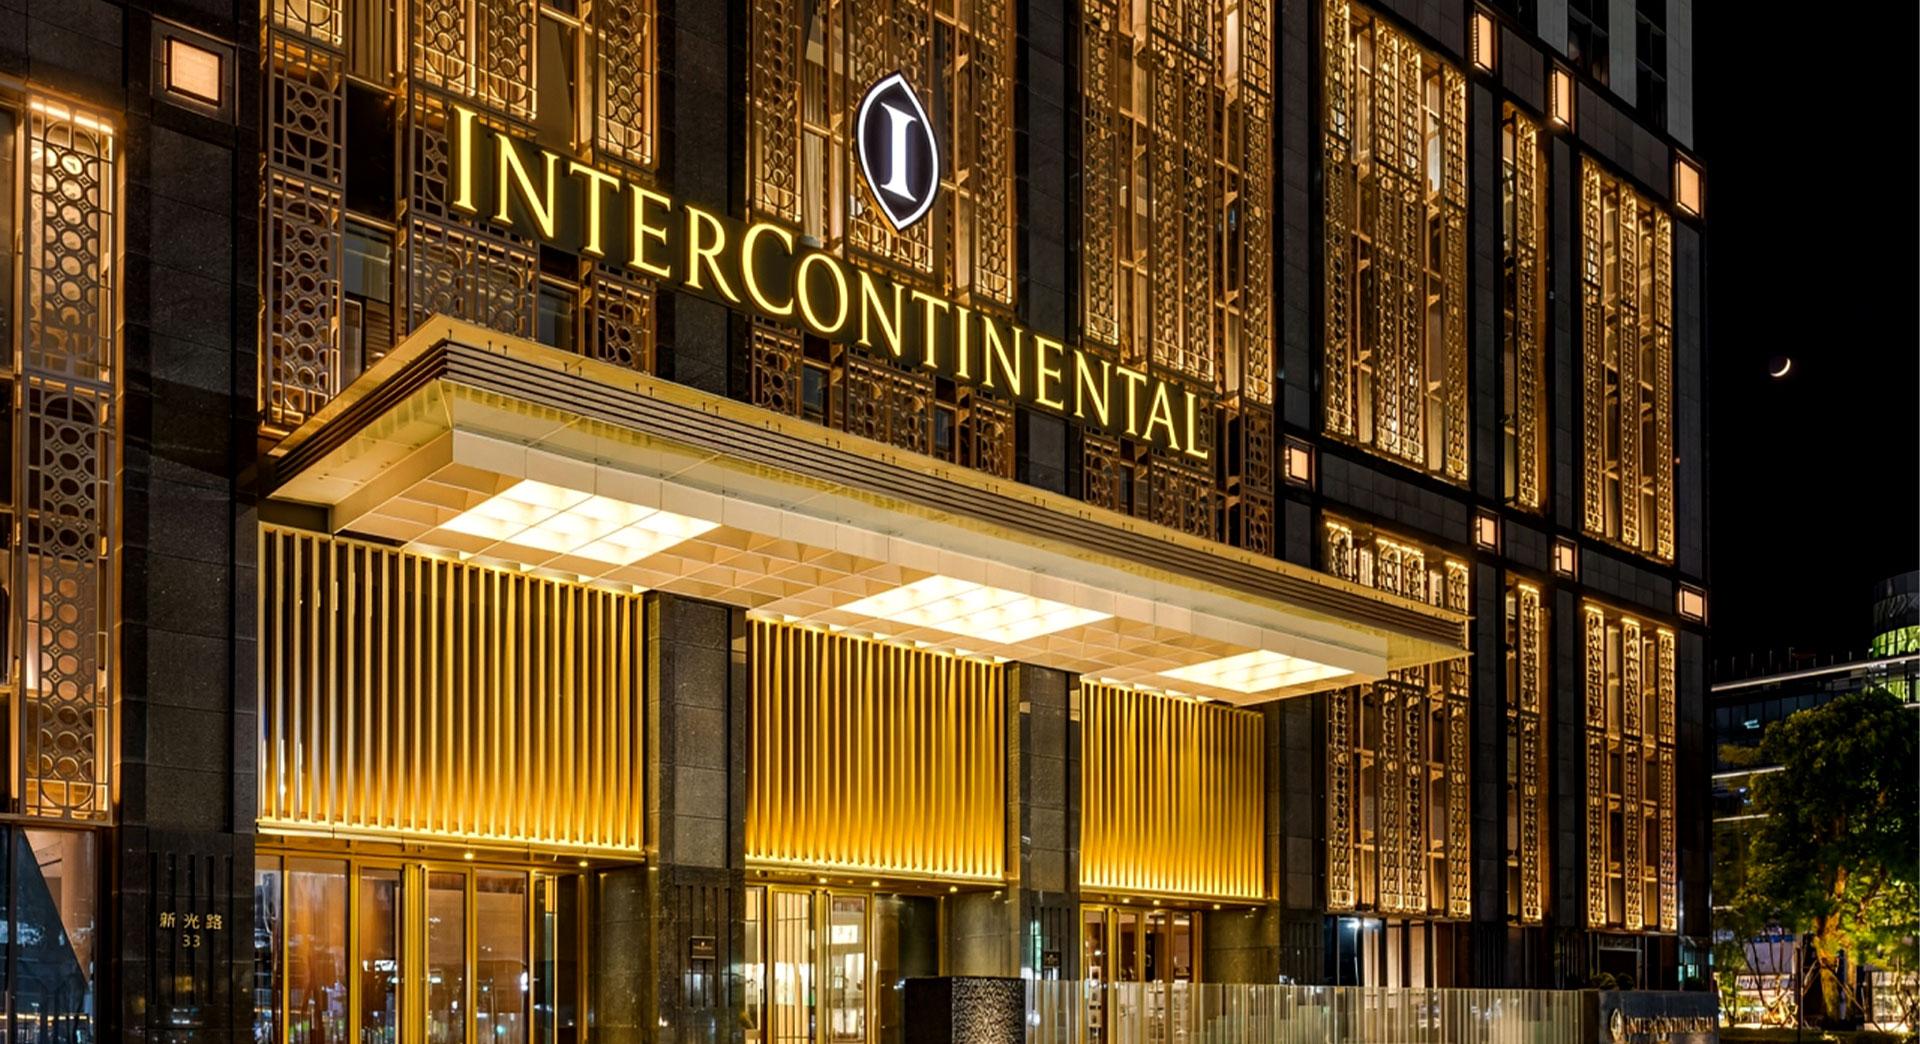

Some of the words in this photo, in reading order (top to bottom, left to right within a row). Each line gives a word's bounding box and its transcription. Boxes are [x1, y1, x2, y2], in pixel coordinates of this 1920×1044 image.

[880, 102, 917, 202] I
[453, 104, 1208, 459] INTERCONTINENTAL
[160, 912, 222, 929] 新光路
[182, 934, 201, 948] 33
